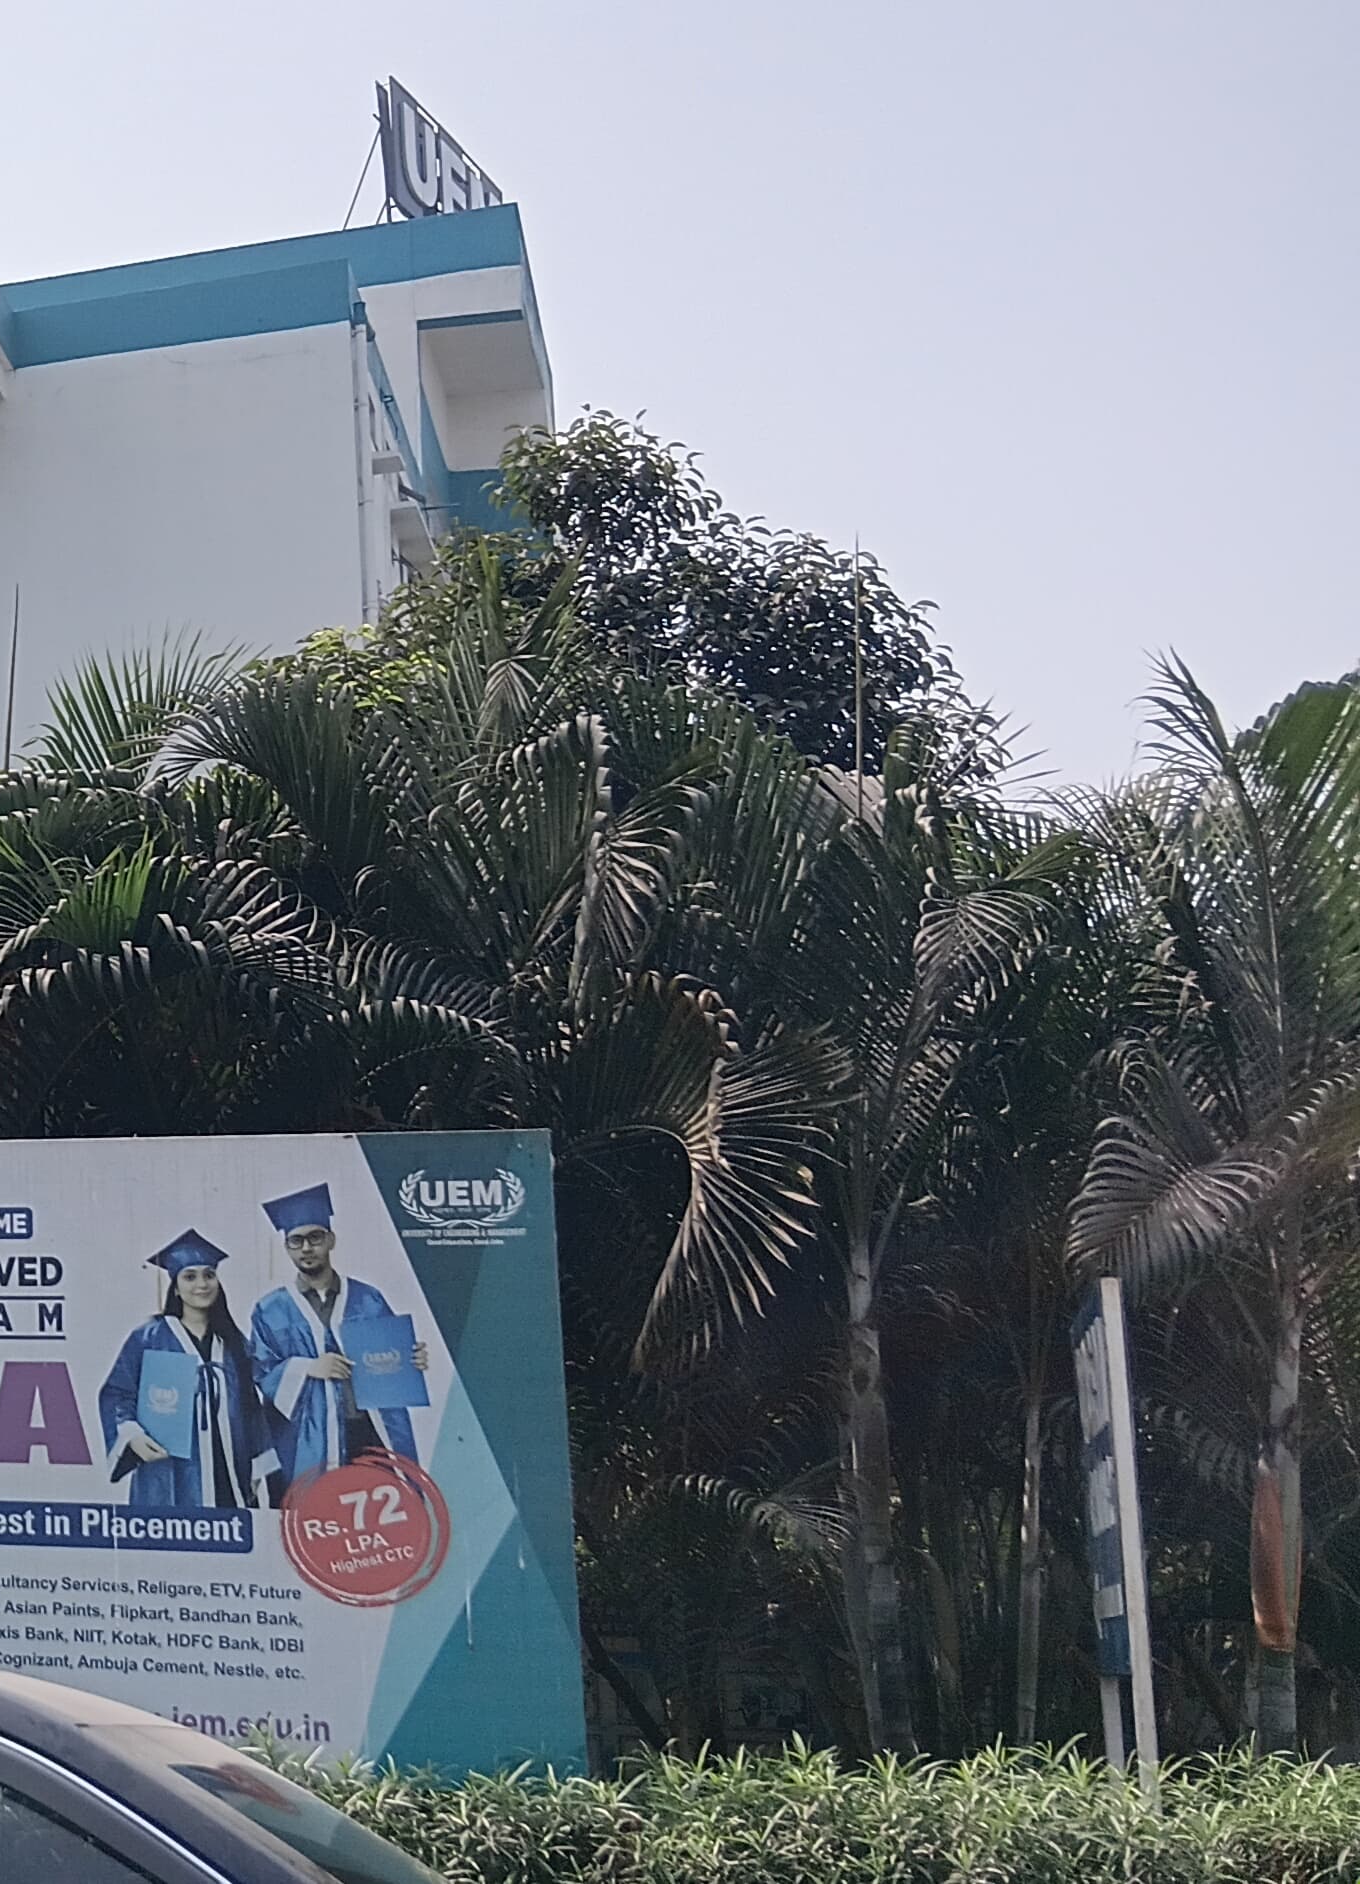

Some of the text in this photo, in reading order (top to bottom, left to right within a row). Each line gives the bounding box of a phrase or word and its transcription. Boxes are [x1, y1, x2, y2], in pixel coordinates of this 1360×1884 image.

[419, 1179, 503, 1207] UEM
[45, 1507, 71, 1536] in
[81, 1508, 244, 1542] Placement
[303, 1485, 408, 1541] Rs. 72
[345, 1532, 389, 1554] LPA
[330, 1545, 414, 1574] Highest CTC
[61, 1577, 134, 1595] Services,
[138, 1580, 207, 1598] Religare,
[210, 1582, 246, 1600] ETV,
[249, 1585, 301, 1600] Future
[4, 1600, 47, 1616] Asian
[52, 1602, 105, 1619] Paints,
[110, 1604, 174, 1623] Flipkart,
[179, 1607, 251, 1625] Bandhan
[257, 1610, 303, 1628] Bank,
[25, 1626, 68, 1643] Bank,
[73, 1628, 107, 1646] NIIT,
[112, 1630, 161, 1648] Kotak,
[167, 1633, 213, 1650] HDFC
[218, 1635, 265, 1653] Bank,
[269, 1637, 304, 1653] IDBI
[78, 1655, 138, 1674] Ambuja
[143, 1658, 209, 1677] Cement,
[213, 1662, 269, 1680] Nestle,
[275, 1665, 305, 1680] etc.
[170, 1706, 331, 1742] iem.edu.in
